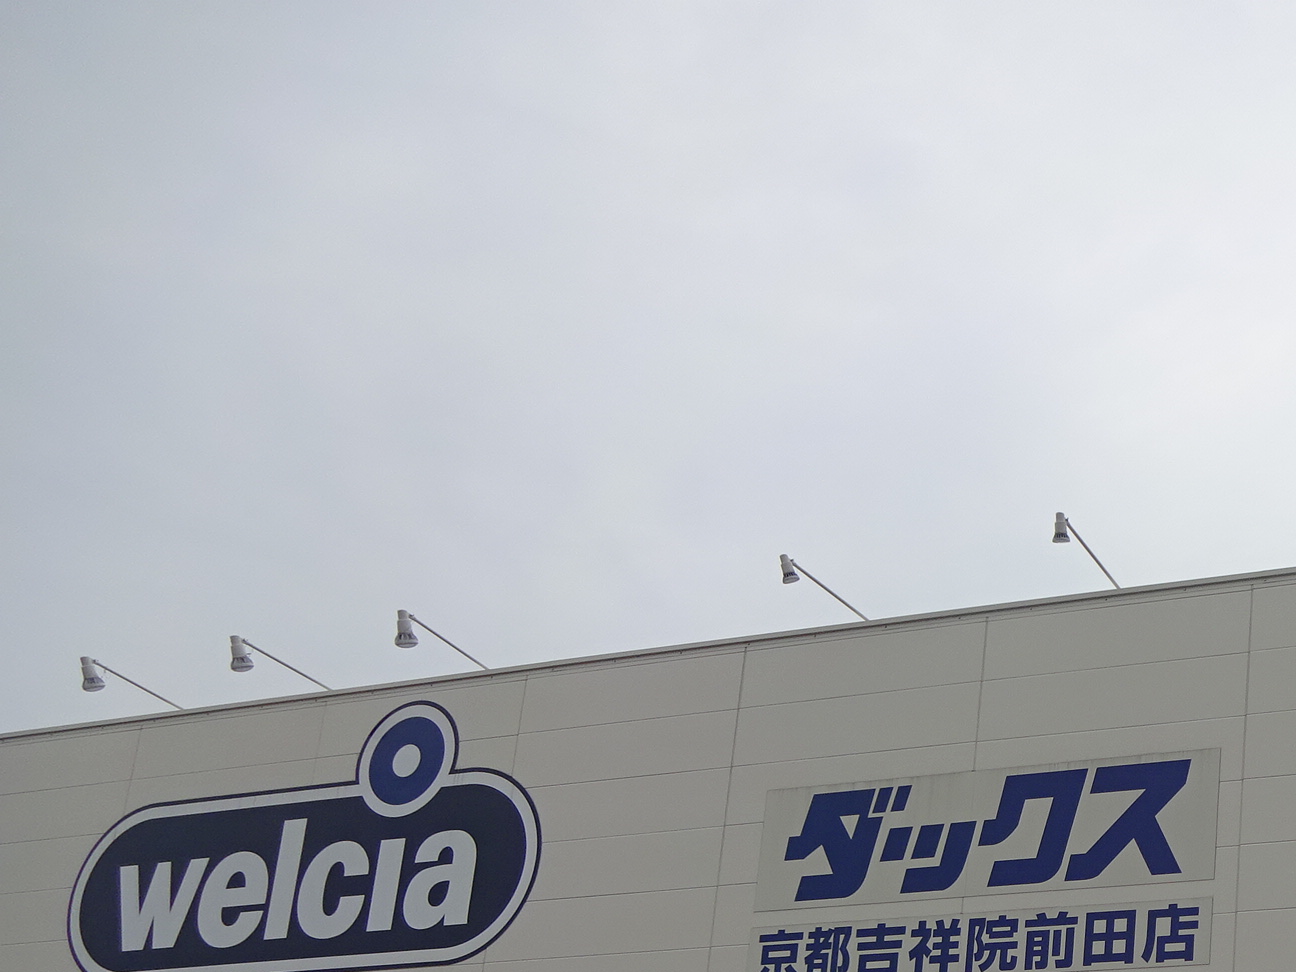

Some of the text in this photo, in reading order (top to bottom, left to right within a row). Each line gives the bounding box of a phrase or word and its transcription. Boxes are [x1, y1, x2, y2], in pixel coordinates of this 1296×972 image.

[120, 818, 477, 953] welcia
[784, 759, 1191, 902] ダックス
